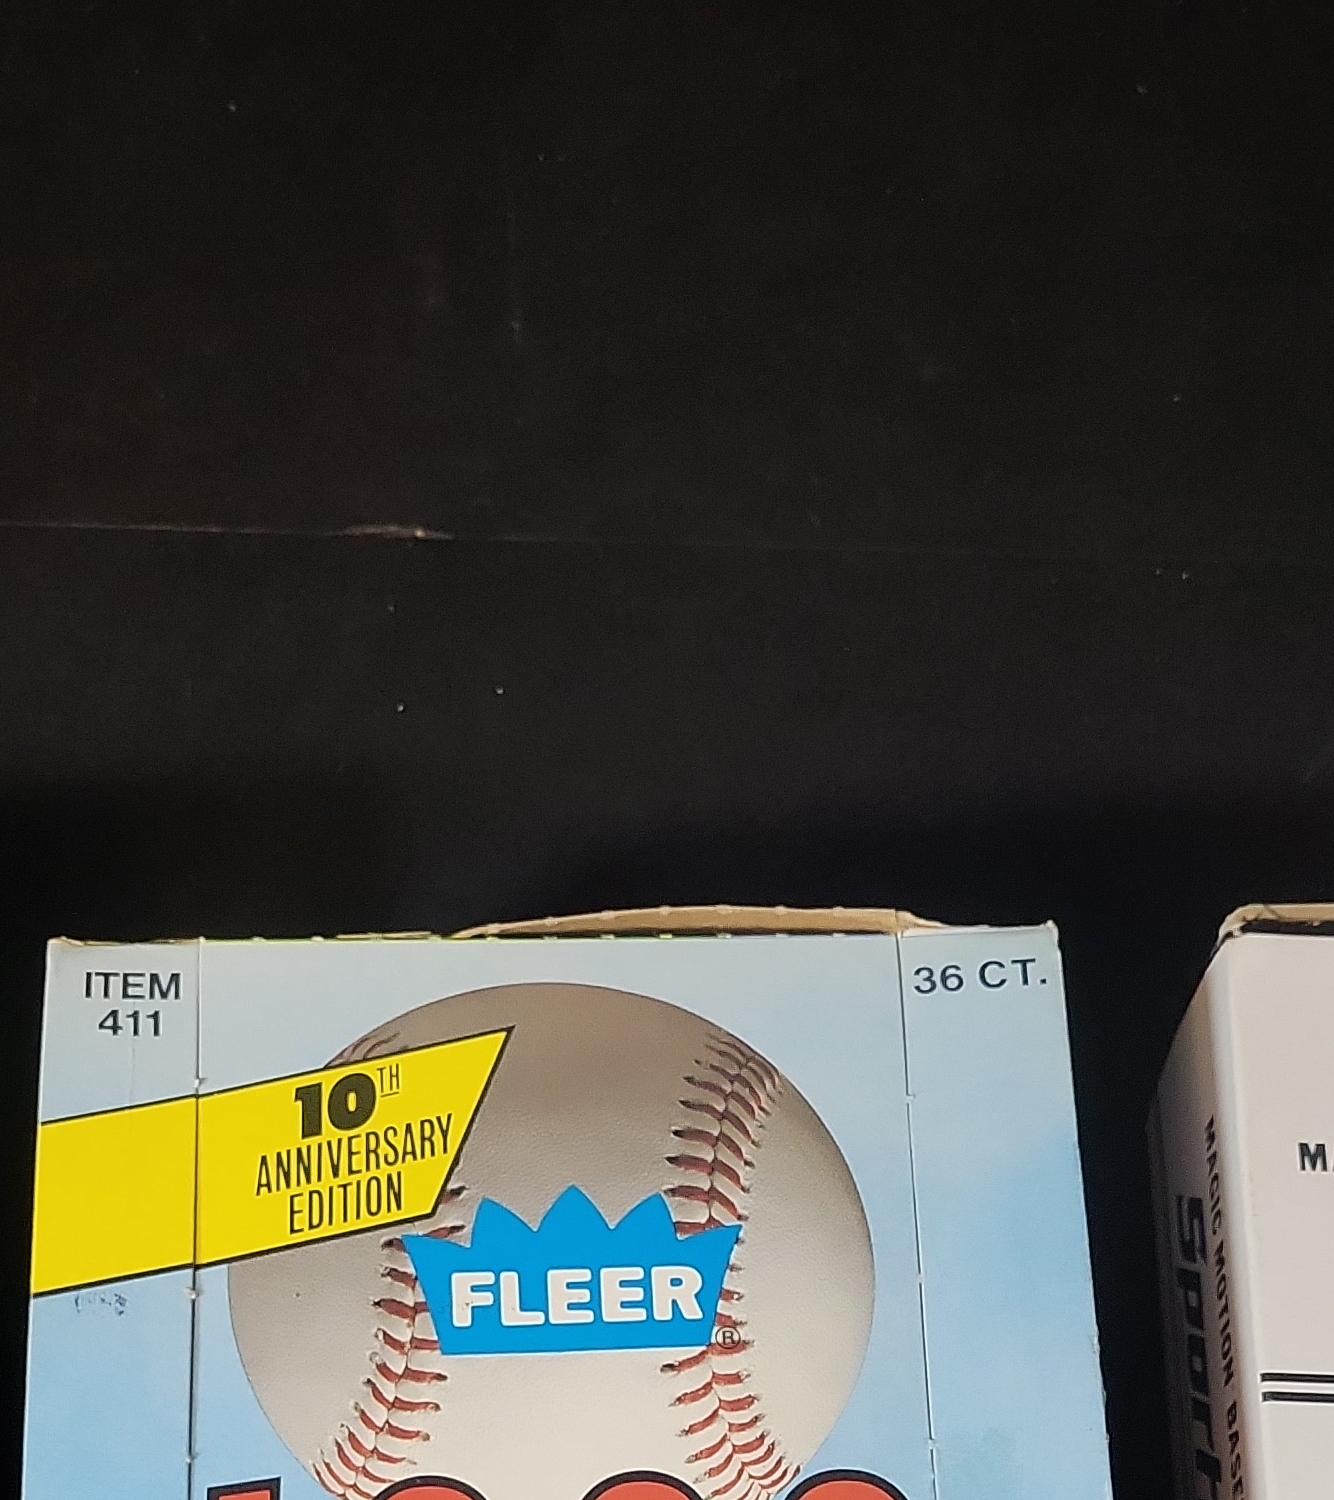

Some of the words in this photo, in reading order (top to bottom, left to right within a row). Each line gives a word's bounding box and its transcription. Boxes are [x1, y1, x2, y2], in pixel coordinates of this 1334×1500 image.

[84, 970, 182, 1001] ITEM
[913, 964, 964, 994] 36
[976, 957, 1049, 991] CT.
[98, 1009, 163, 1037] 411
[255, 1113, 454, 1197] ANNIVERSARY
[1203, 1116, 1223, 1236] MAGIC
[289, 1170, 404, 1236] EDITION
[450, 1264, 704, 1328] FLEER
[1212, 1239, 1236, 1389] MOTION
